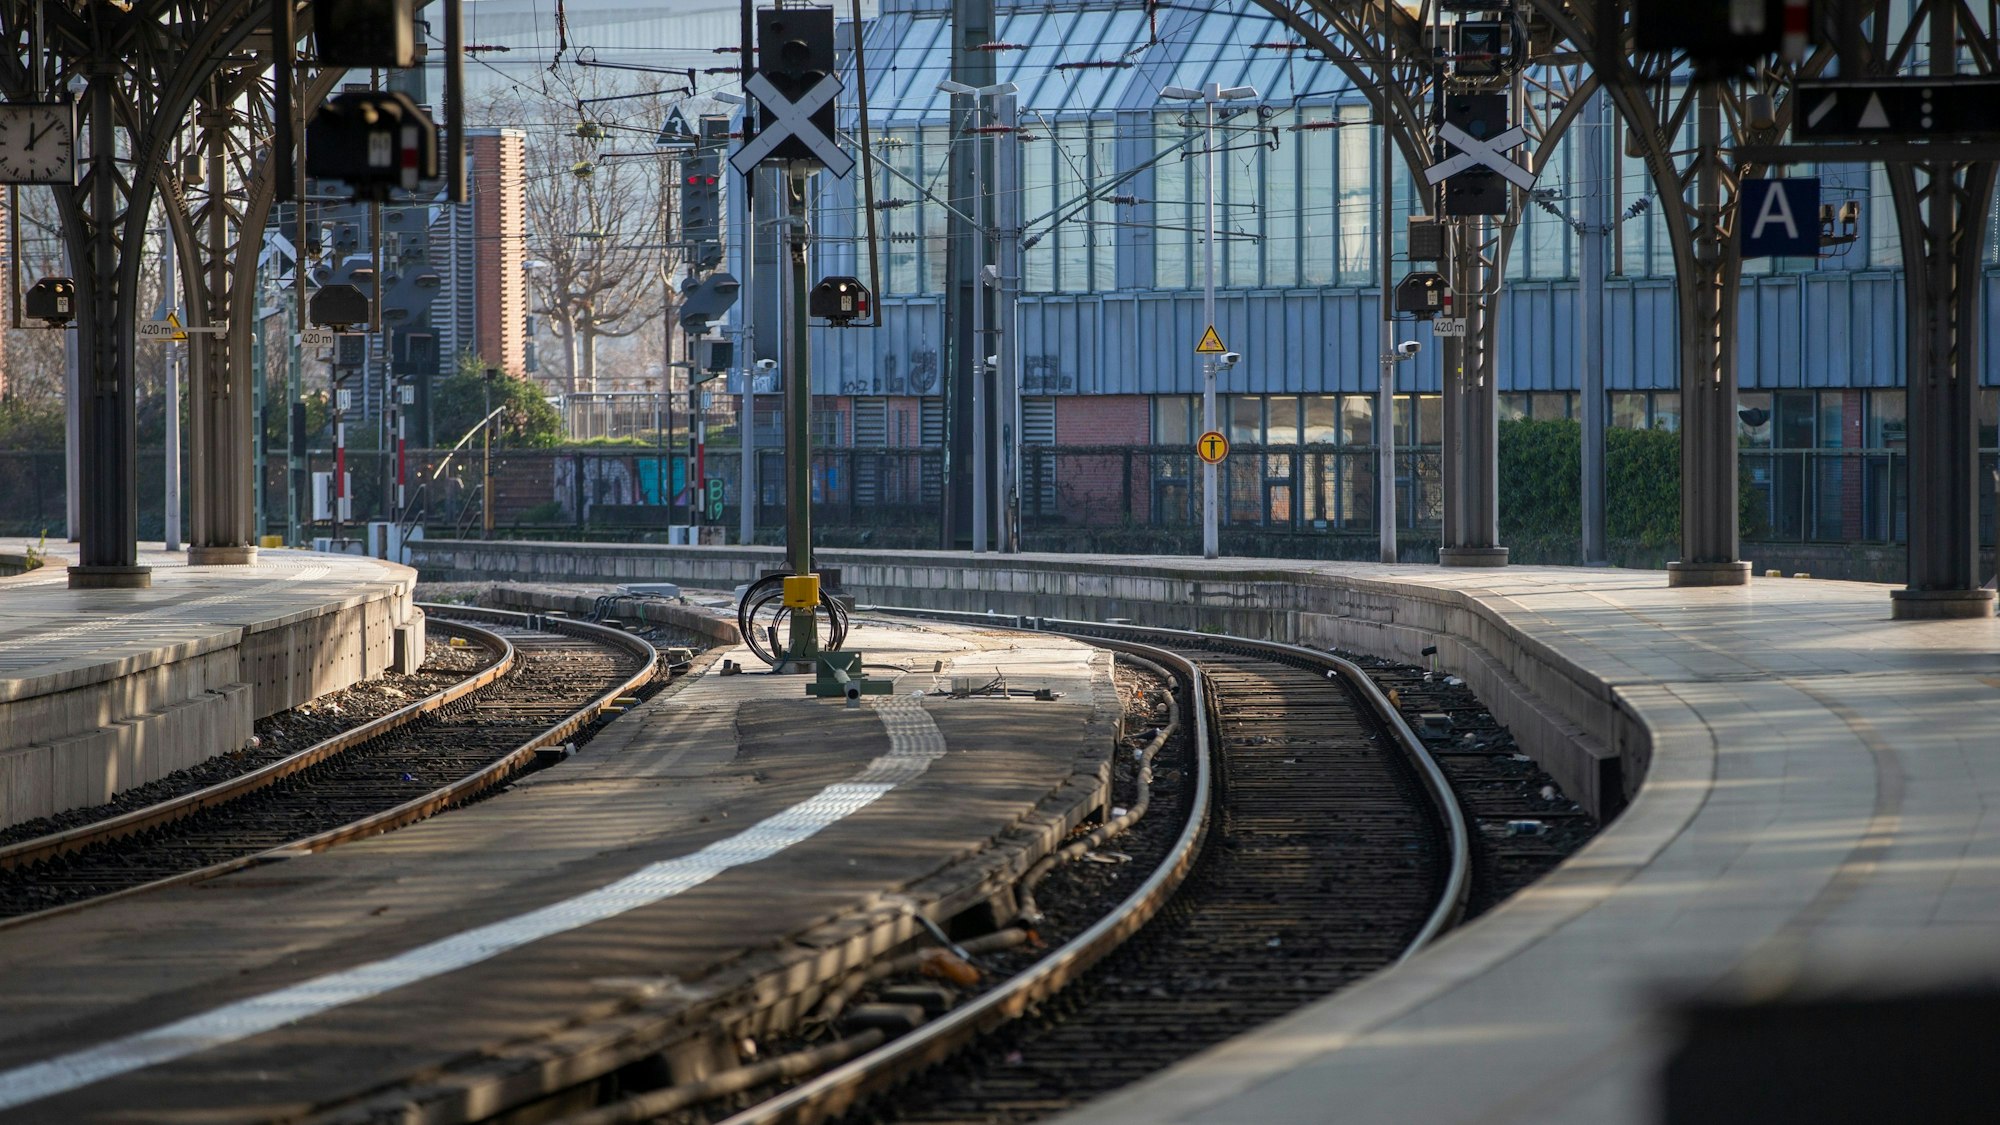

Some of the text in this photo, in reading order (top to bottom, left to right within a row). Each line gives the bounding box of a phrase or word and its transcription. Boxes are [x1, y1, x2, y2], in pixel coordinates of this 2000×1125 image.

[1751, 181, 1799, 239] A
[141, 324, 171, 335] 420 m
[1435, 322, 1464, 332] 420 m
[302, 333, 332, 344] 420 m
[710, 479, 723, 500] B
[709, 502, 723, 520] 19
